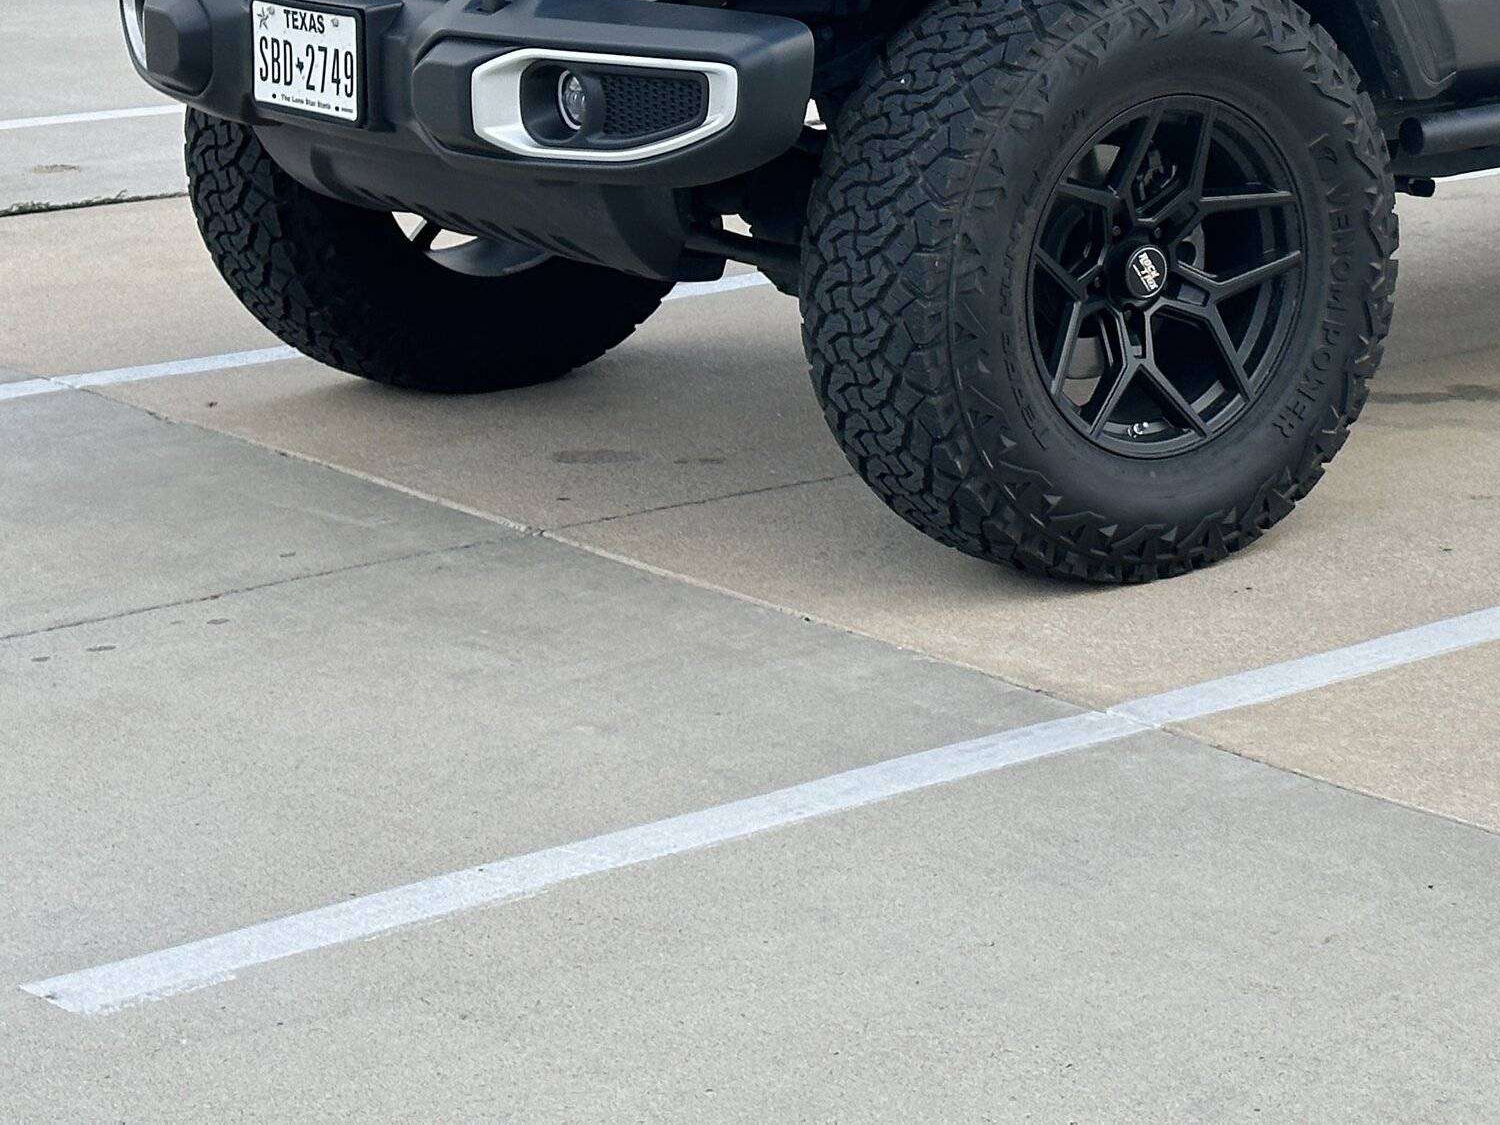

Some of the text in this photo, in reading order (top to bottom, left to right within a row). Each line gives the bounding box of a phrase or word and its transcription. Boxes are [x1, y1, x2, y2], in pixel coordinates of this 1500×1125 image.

[283, 9, 325, 34] TEXAS
[281, 94, 291, 102] The
[1272, 181, 1356, 438] VENOM POWER
